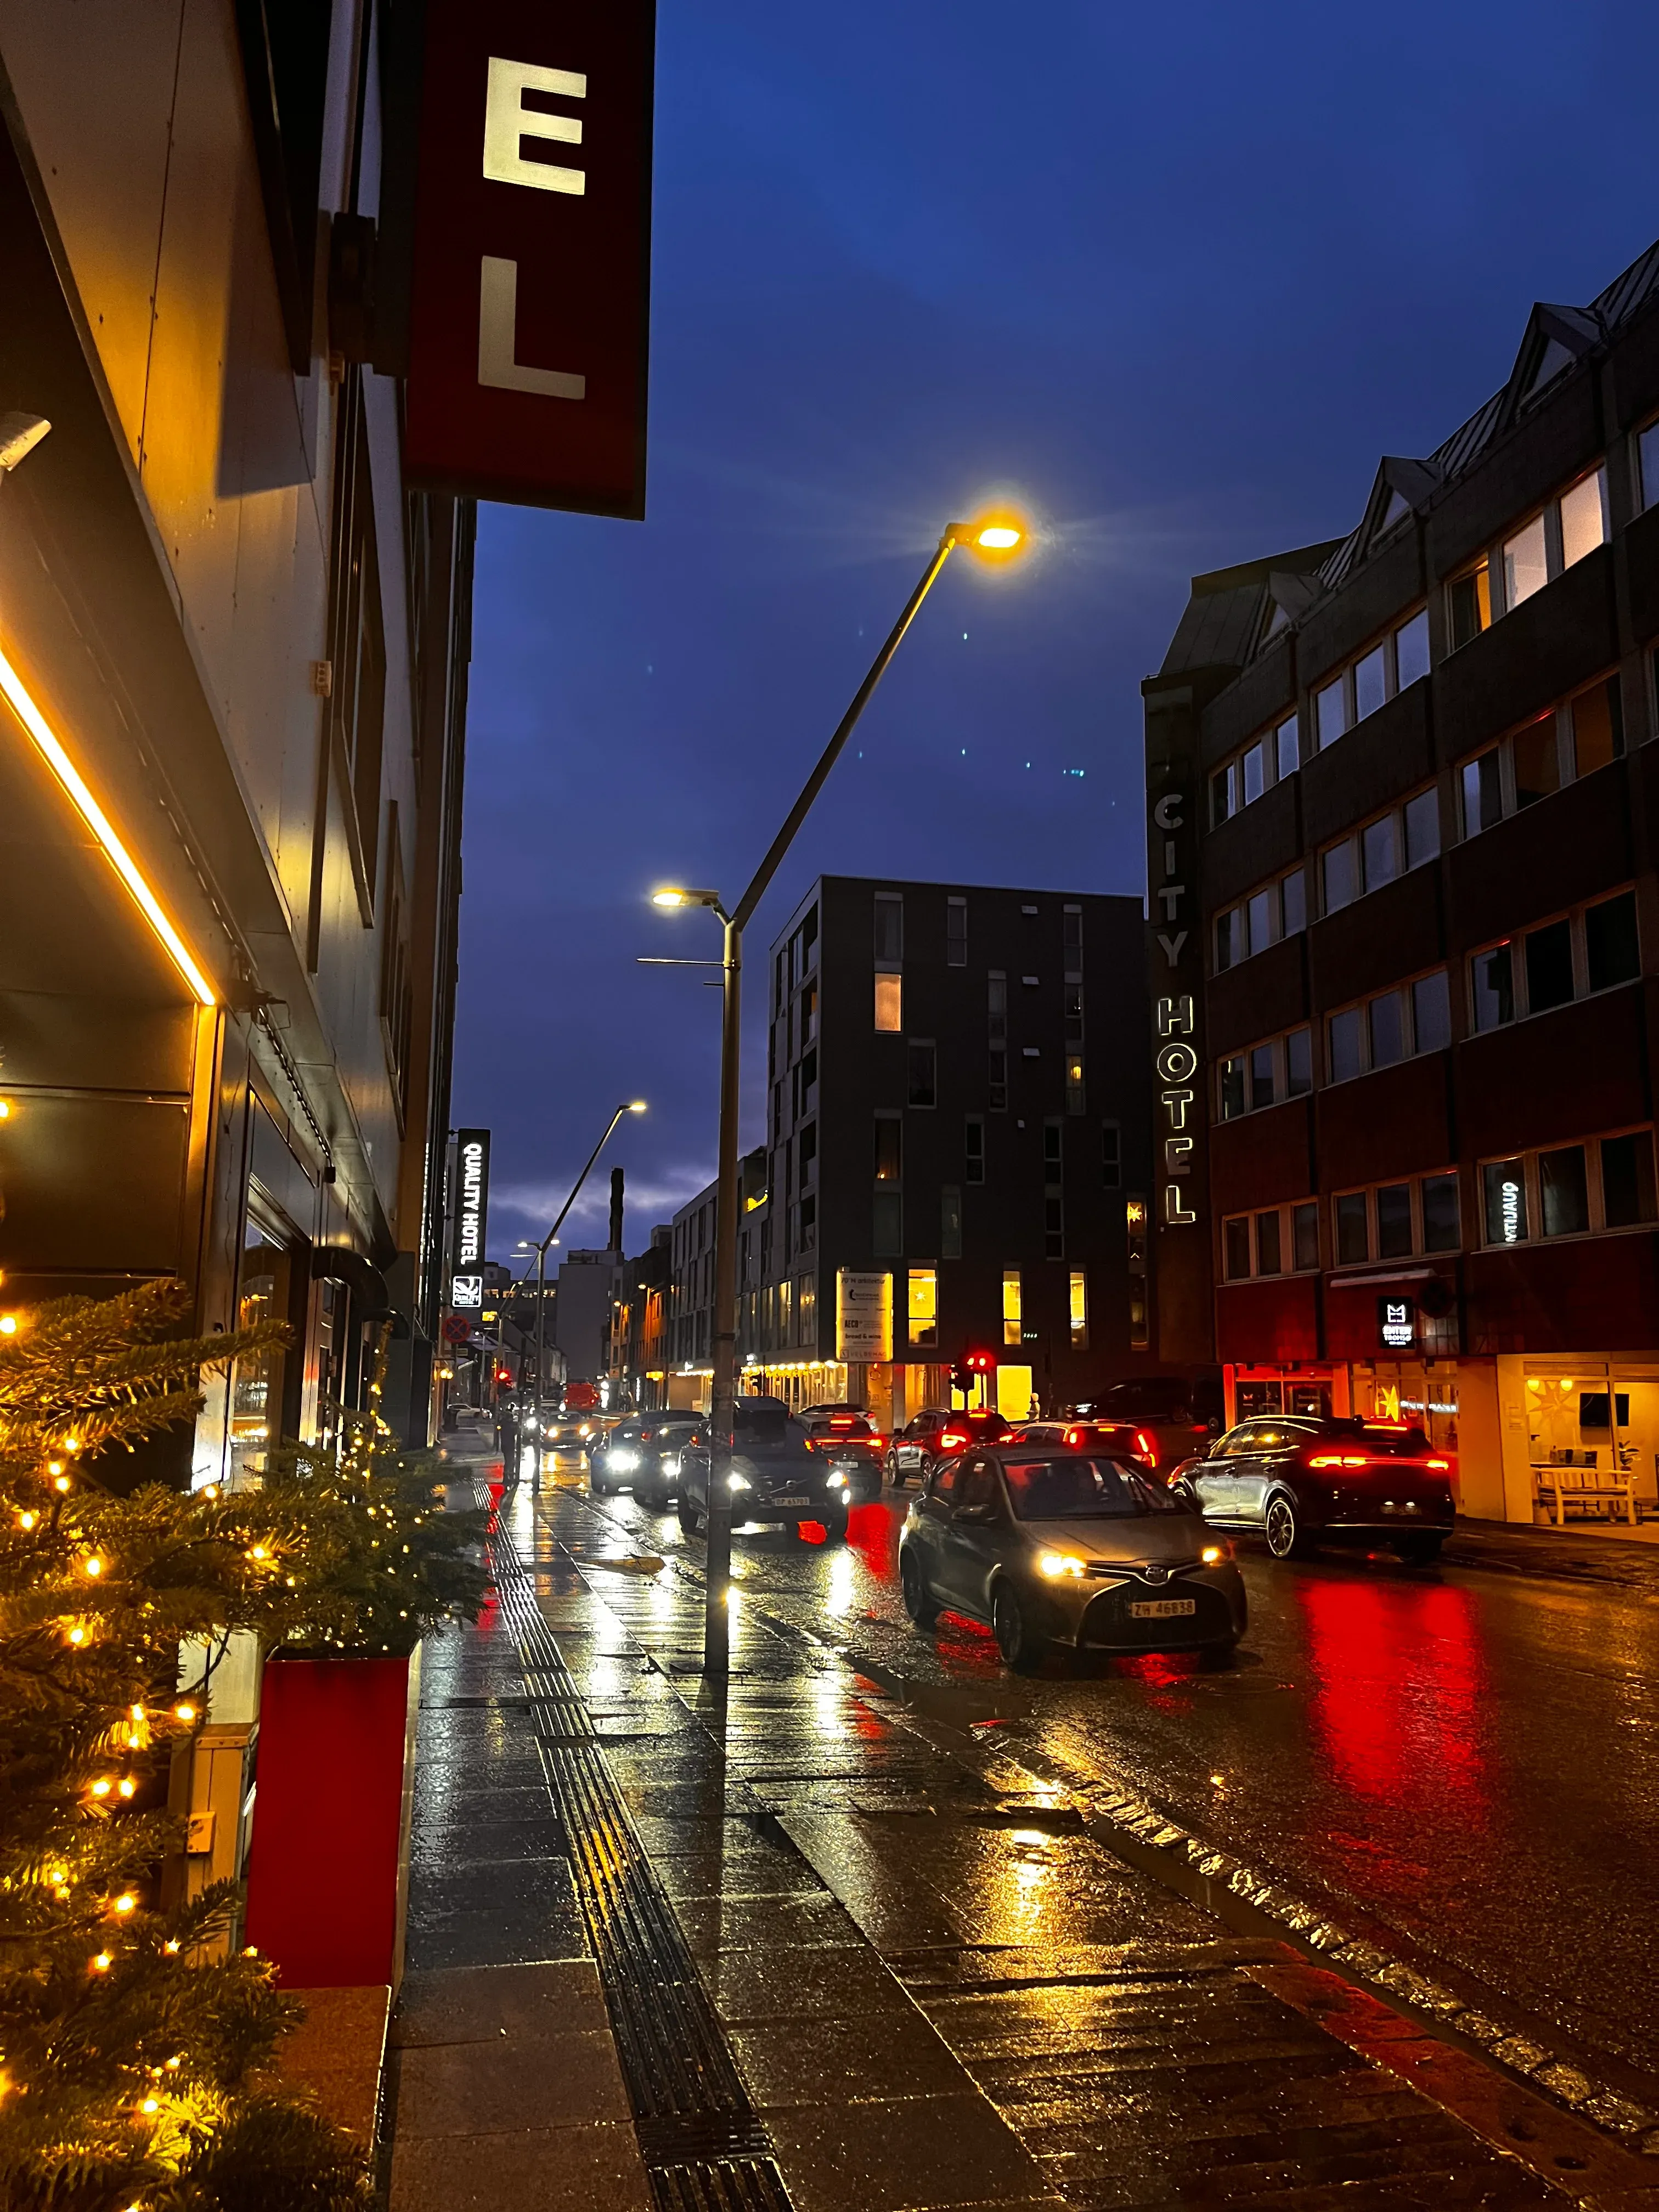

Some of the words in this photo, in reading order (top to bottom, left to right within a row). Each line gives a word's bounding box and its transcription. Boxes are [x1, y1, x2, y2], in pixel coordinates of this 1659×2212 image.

[1154, 794, 1188, 967] CITY
[1157, 995, 1197, 1223] HOTEL
[463, 1142, 482, 1211] QUALITY
[460, 1212, 479, 1265] HOTEL
